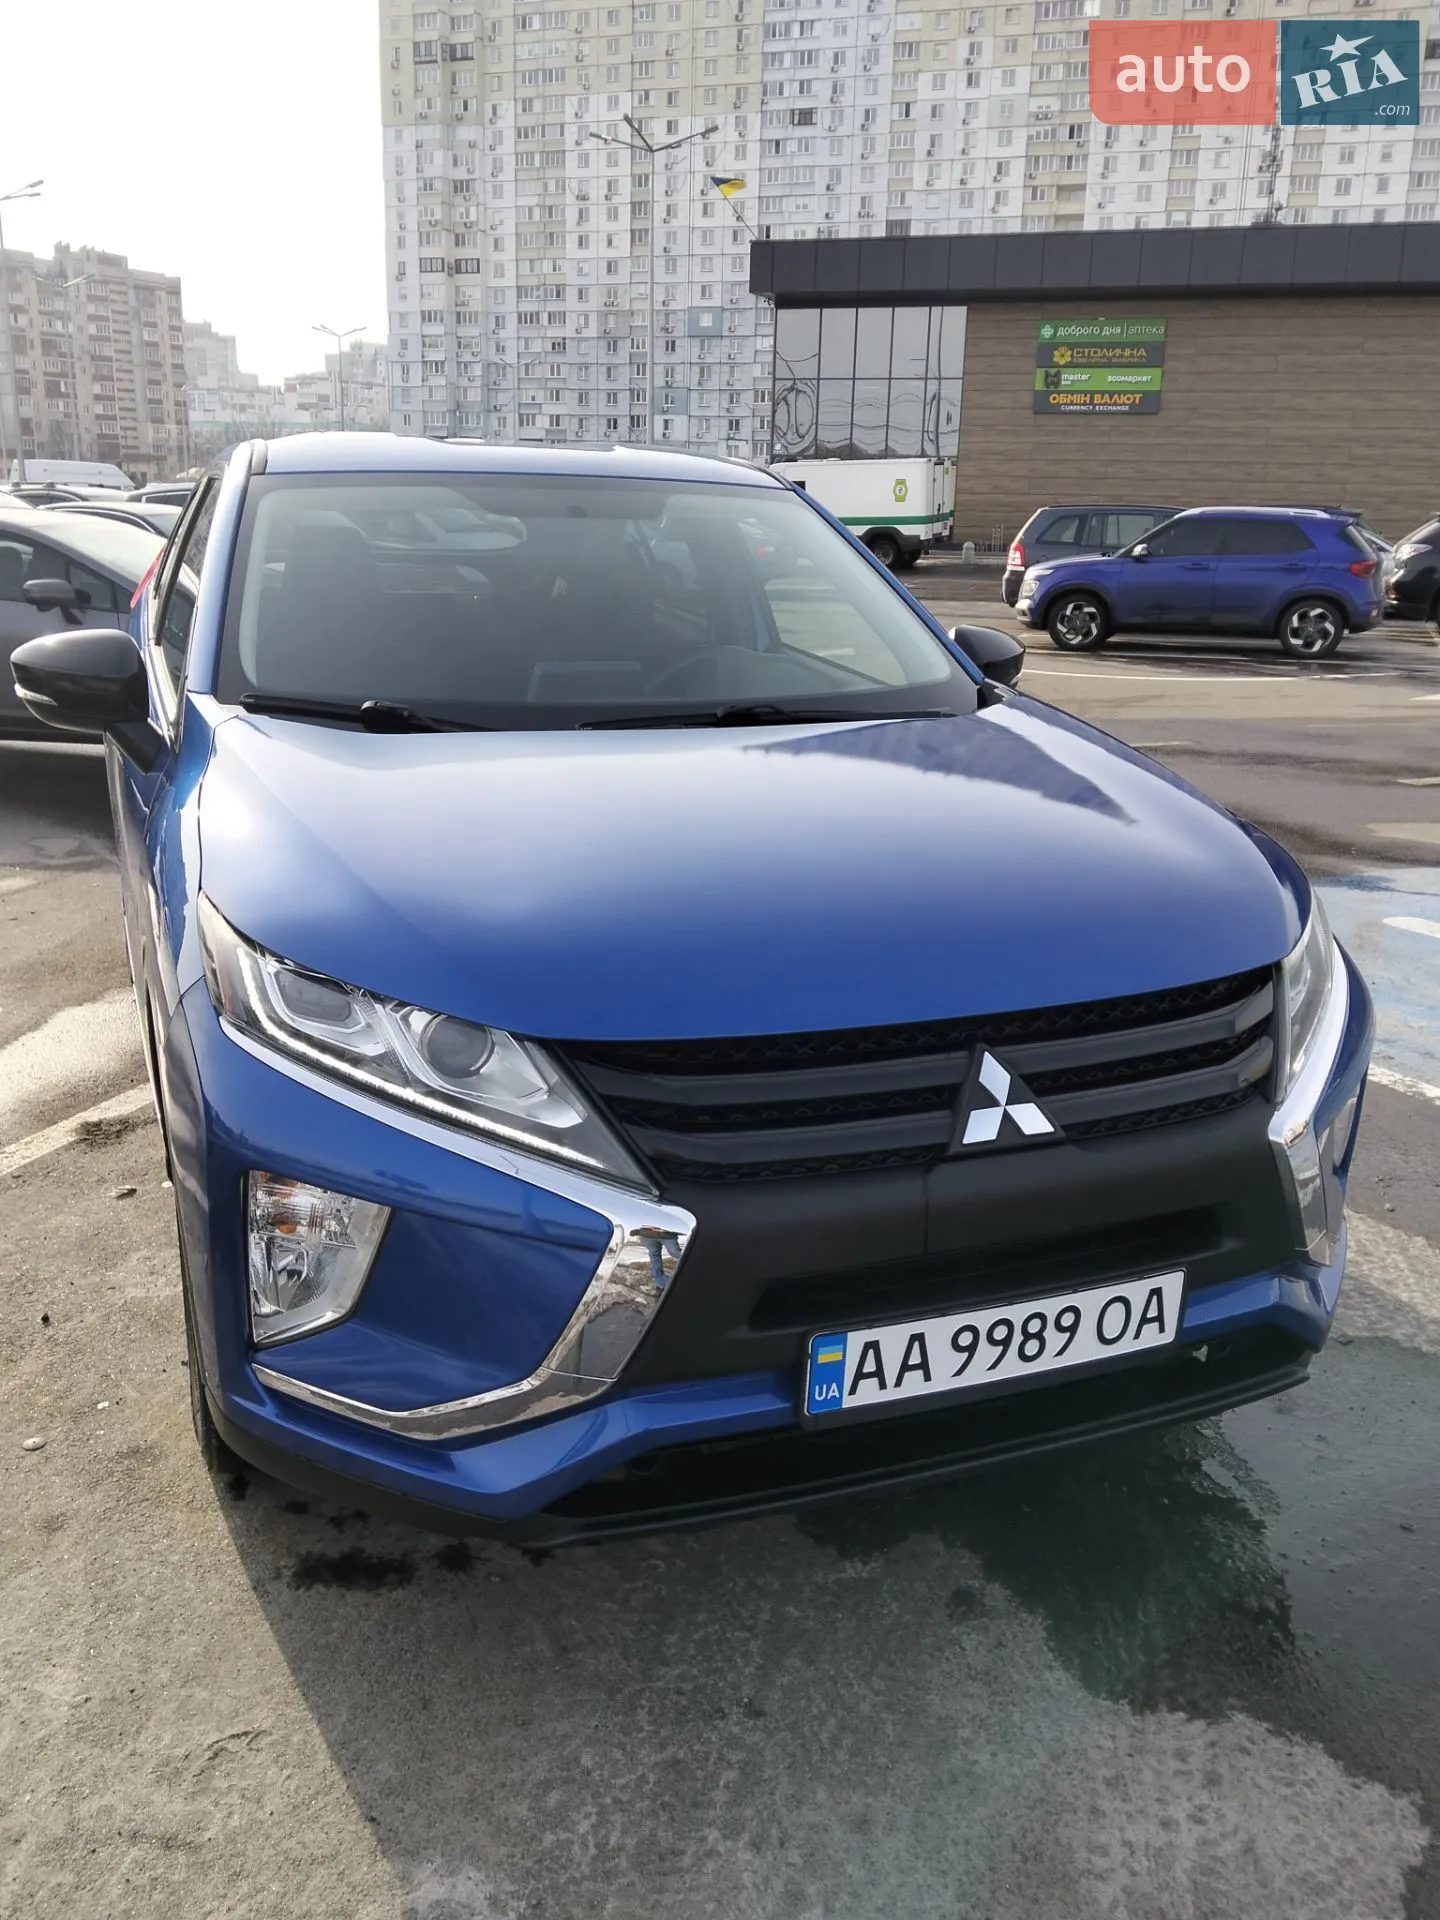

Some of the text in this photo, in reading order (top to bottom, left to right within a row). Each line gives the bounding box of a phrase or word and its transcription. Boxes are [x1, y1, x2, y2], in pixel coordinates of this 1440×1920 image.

[1057, 324, 1165, 337] доброго дня аптека
[1073, 347, 1147, 357] СТОЛИЧНА
[1061, 372, 1091, 381] master
[1107, 374, 1152, 383] зоомаркет
[1049, 393, 1143, 404] ОБМІН ВАЛЮТ
[848, 1286, 1166, 1396] AA 9989 OA
[814, 1382, 840, 1401] UA
